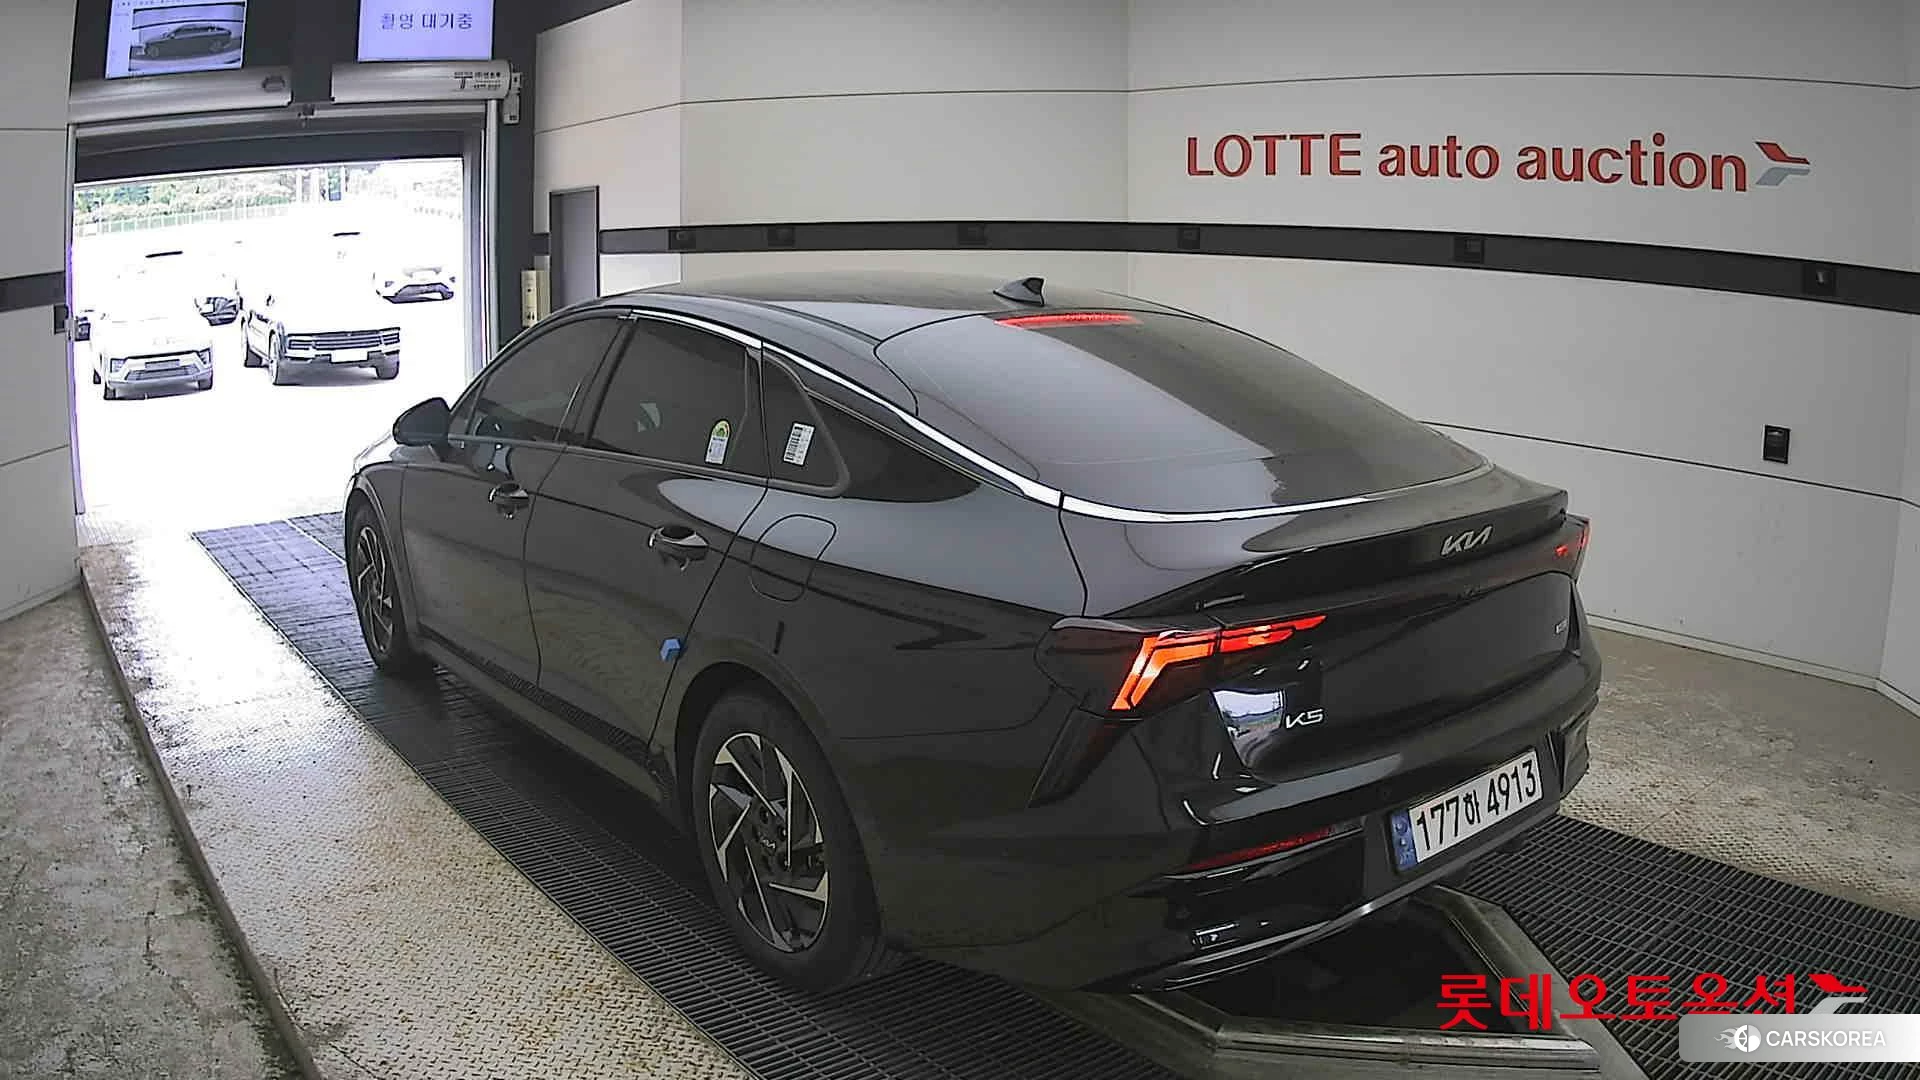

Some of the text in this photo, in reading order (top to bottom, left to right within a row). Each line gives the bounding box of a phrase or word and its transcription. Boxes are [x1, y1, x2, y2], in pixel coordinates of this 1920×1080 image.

[422, 13, 473, 30] 대기중
[1187, 132, 1747, 192] LOTTE auto auction
[1285, 708, 1323, 729] K5
[1416, 789, 1481, 851] 177하
[1487, 759, 1537, 816] 4913
